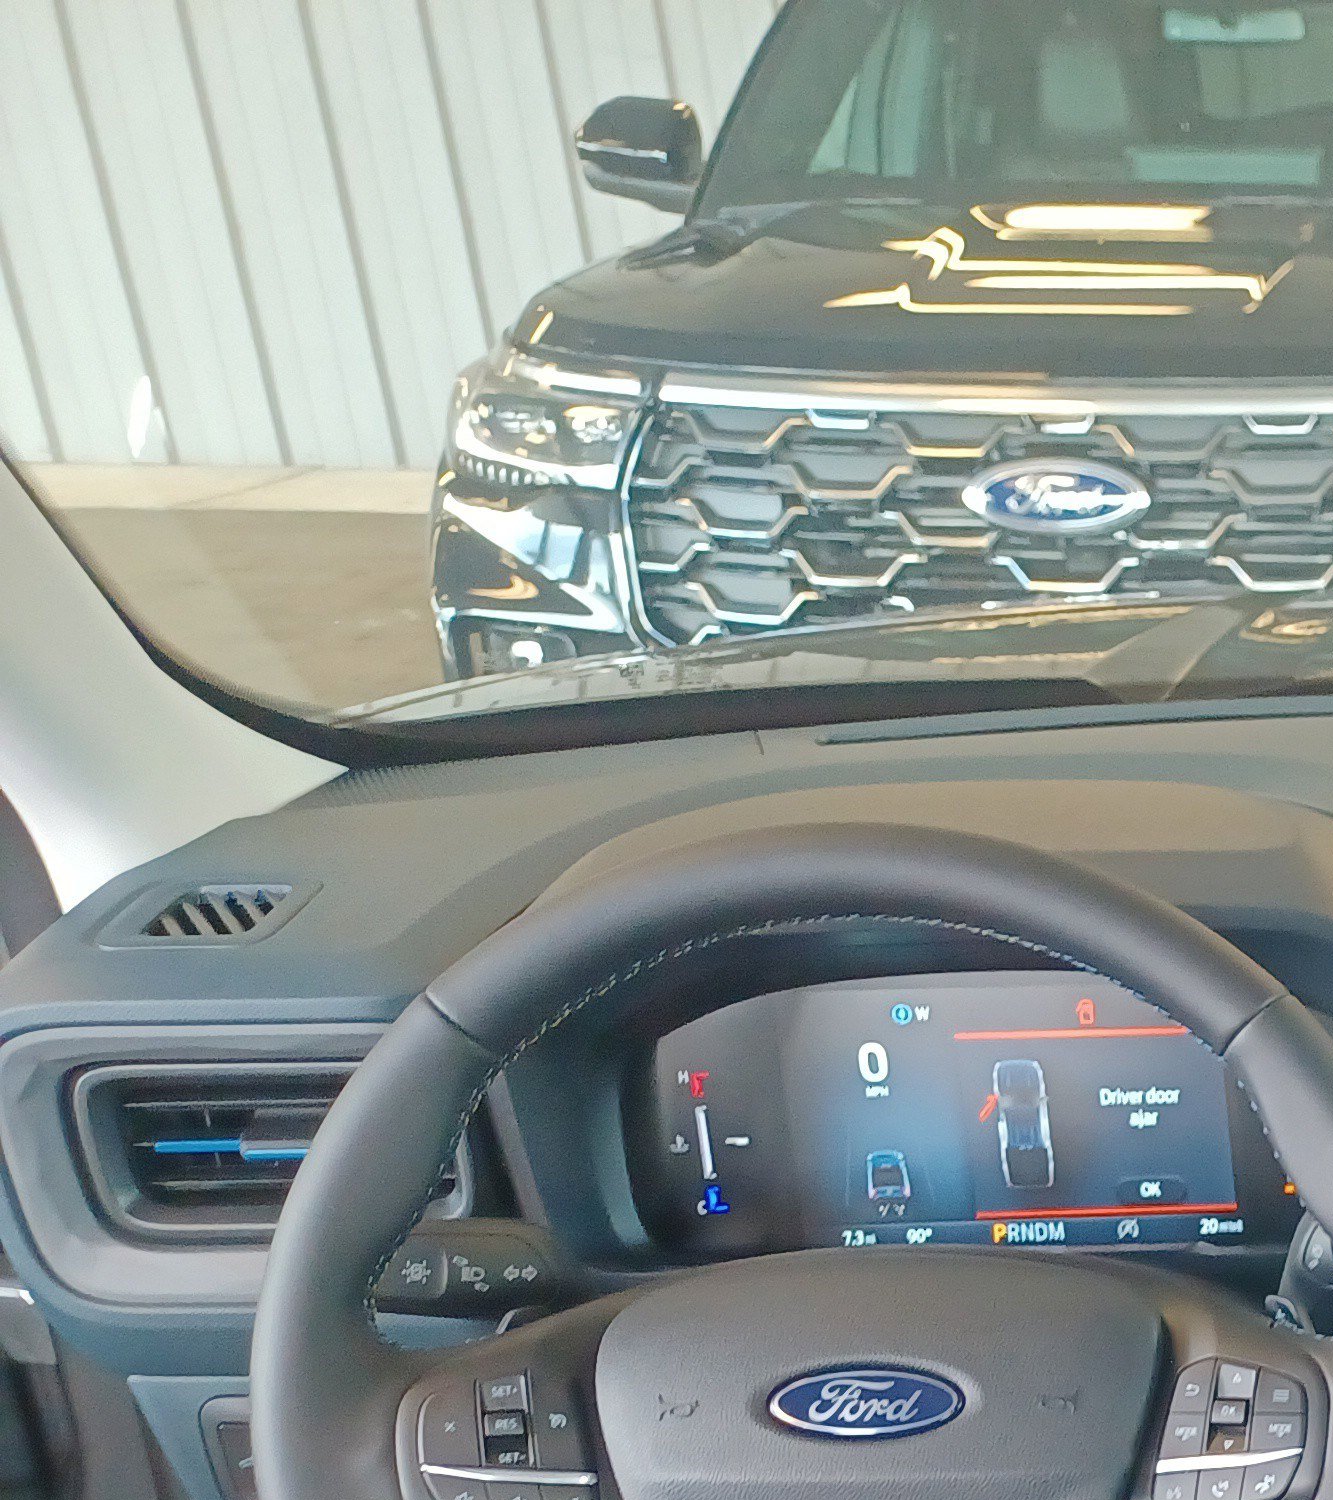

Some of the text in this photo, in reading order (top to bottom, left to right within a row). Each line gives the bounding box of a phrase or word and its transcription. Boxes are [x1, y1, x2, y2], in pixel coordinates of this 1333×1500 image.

[914, 1005, 930, 1021] W
[858, 1042, 888, 1082] 0
[1099, 1086, 1180, 1106] Driver door
[1129, 1109, 1158, 1129] ajar
[1139, 1181, 1162, 1198] OK
[808, 1378, 922, 1423] Ford
